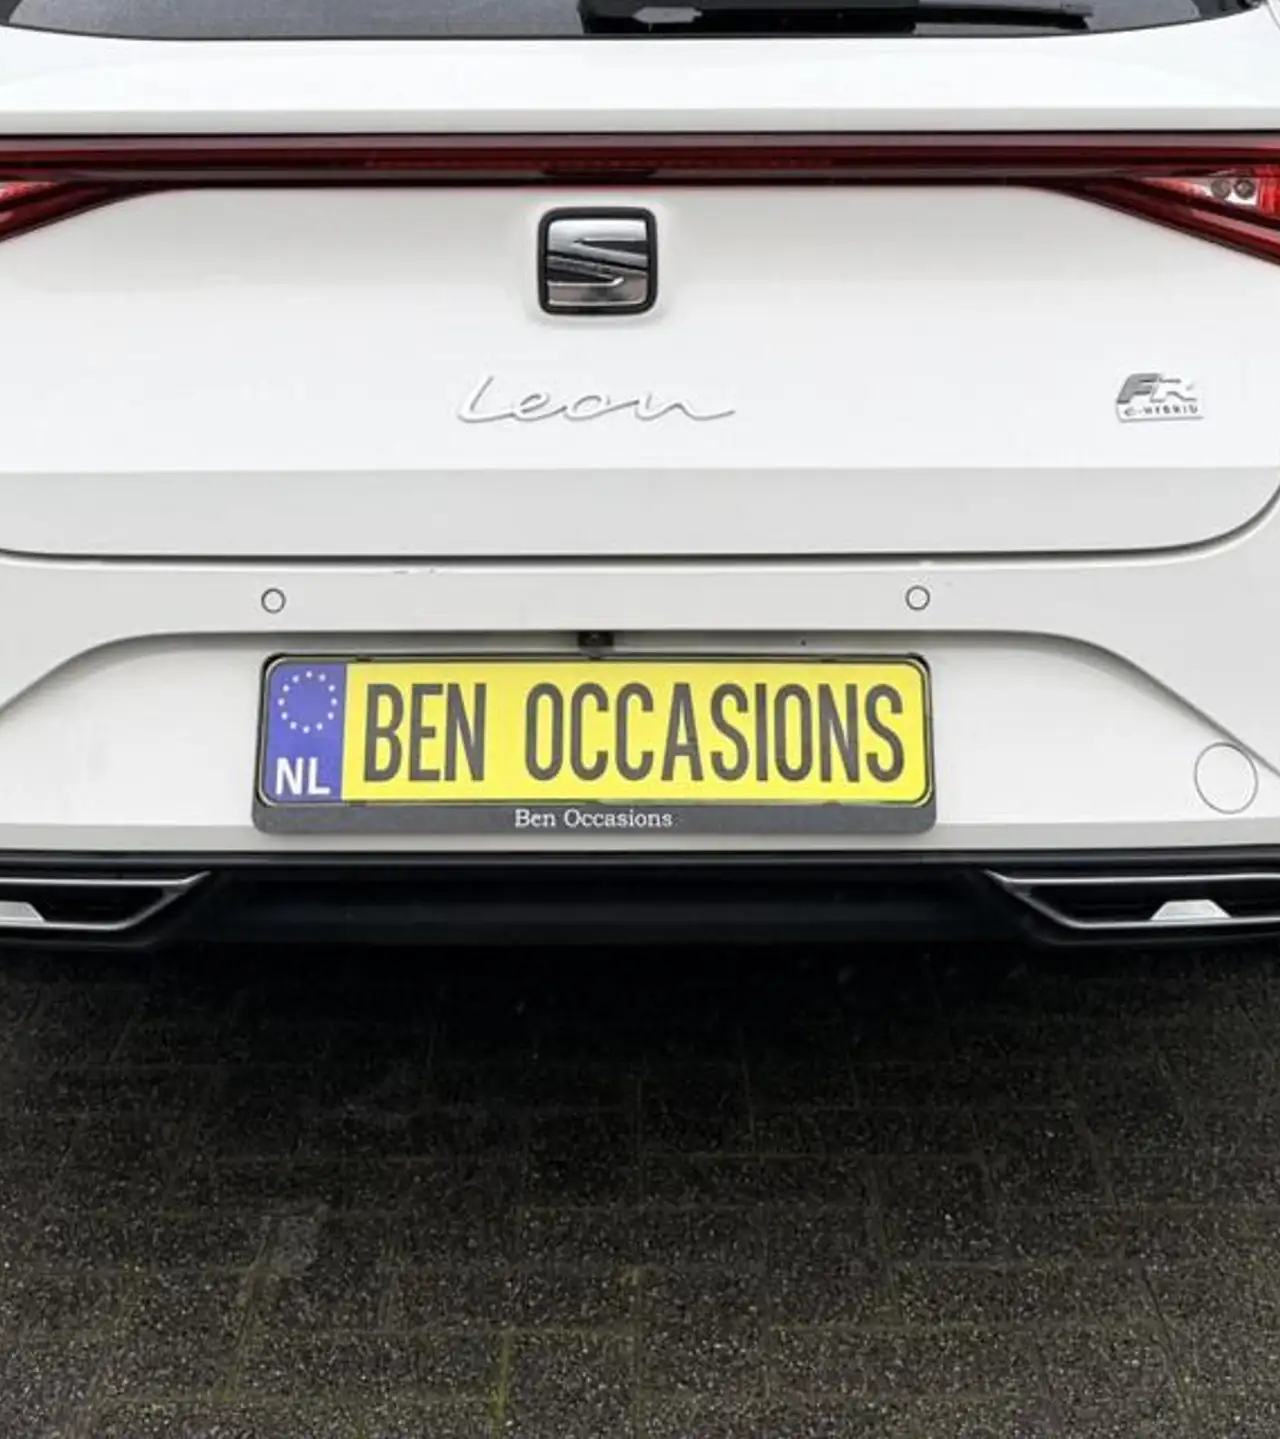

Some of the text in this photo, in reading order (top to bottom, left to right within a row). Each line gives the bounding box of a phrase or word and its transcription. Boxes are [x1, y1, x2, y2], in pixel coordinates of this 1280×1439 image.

[456, 374, 737, 423] Leon
[363, 681, 906, 784] BEN OCCASIONS
[274, 756, 331, 797] NL
[515, 808, 674, 829] Ben Occasions
